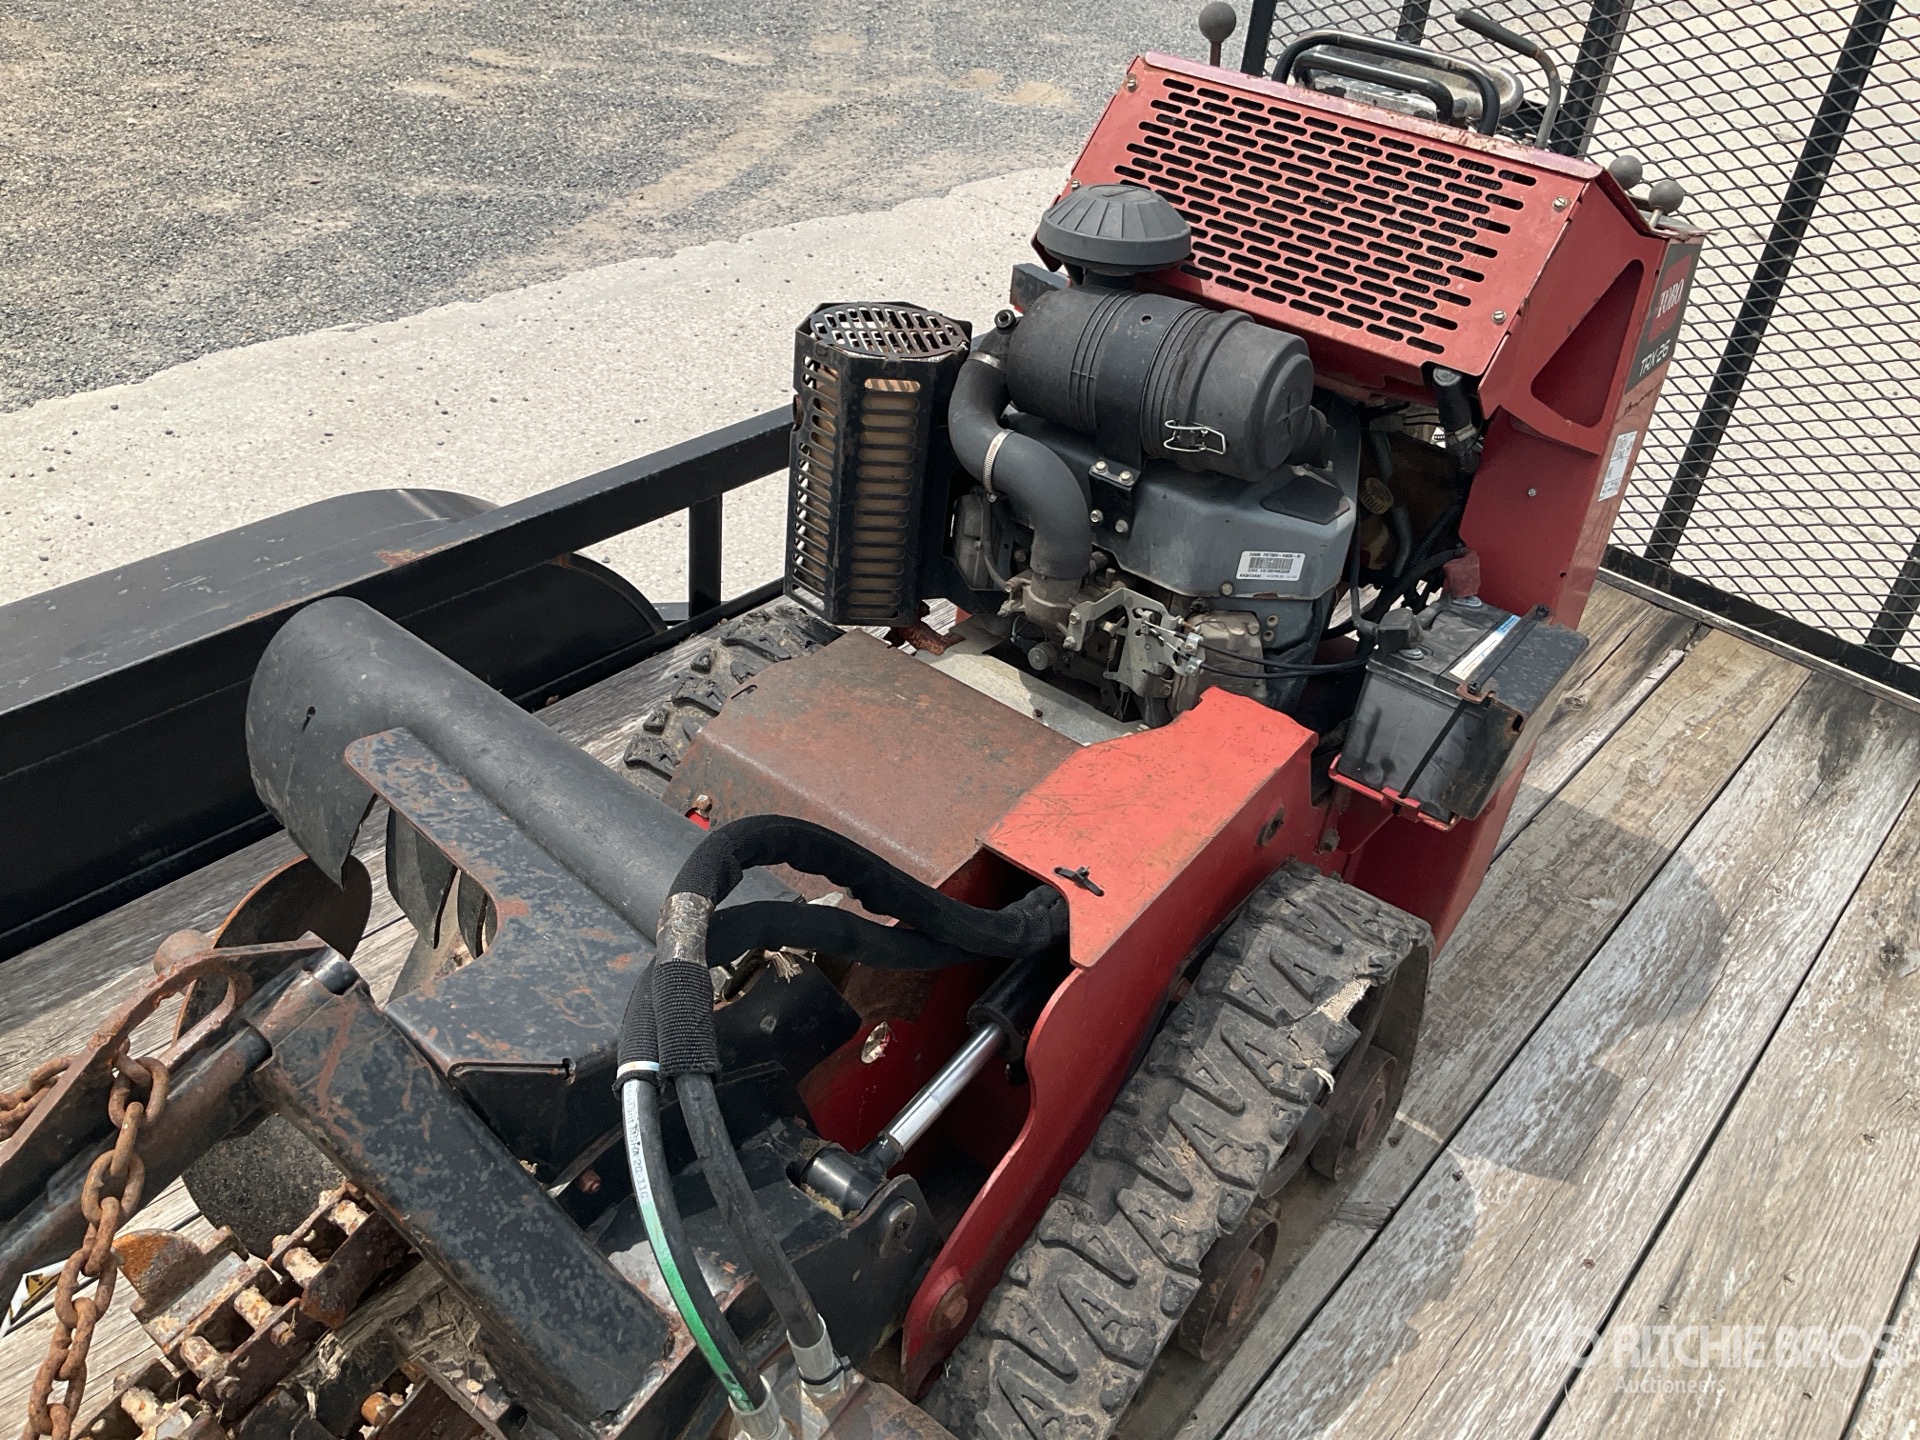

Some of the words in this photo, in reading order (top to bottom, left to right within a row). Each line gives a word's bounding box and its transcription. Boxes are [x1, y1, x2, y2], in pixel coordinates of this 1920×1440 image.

[1656, 278, 1685, 318] TORO
[625, 1083, 635, 1123] esistant
[627, 1125, 640, 1158] MSHA
